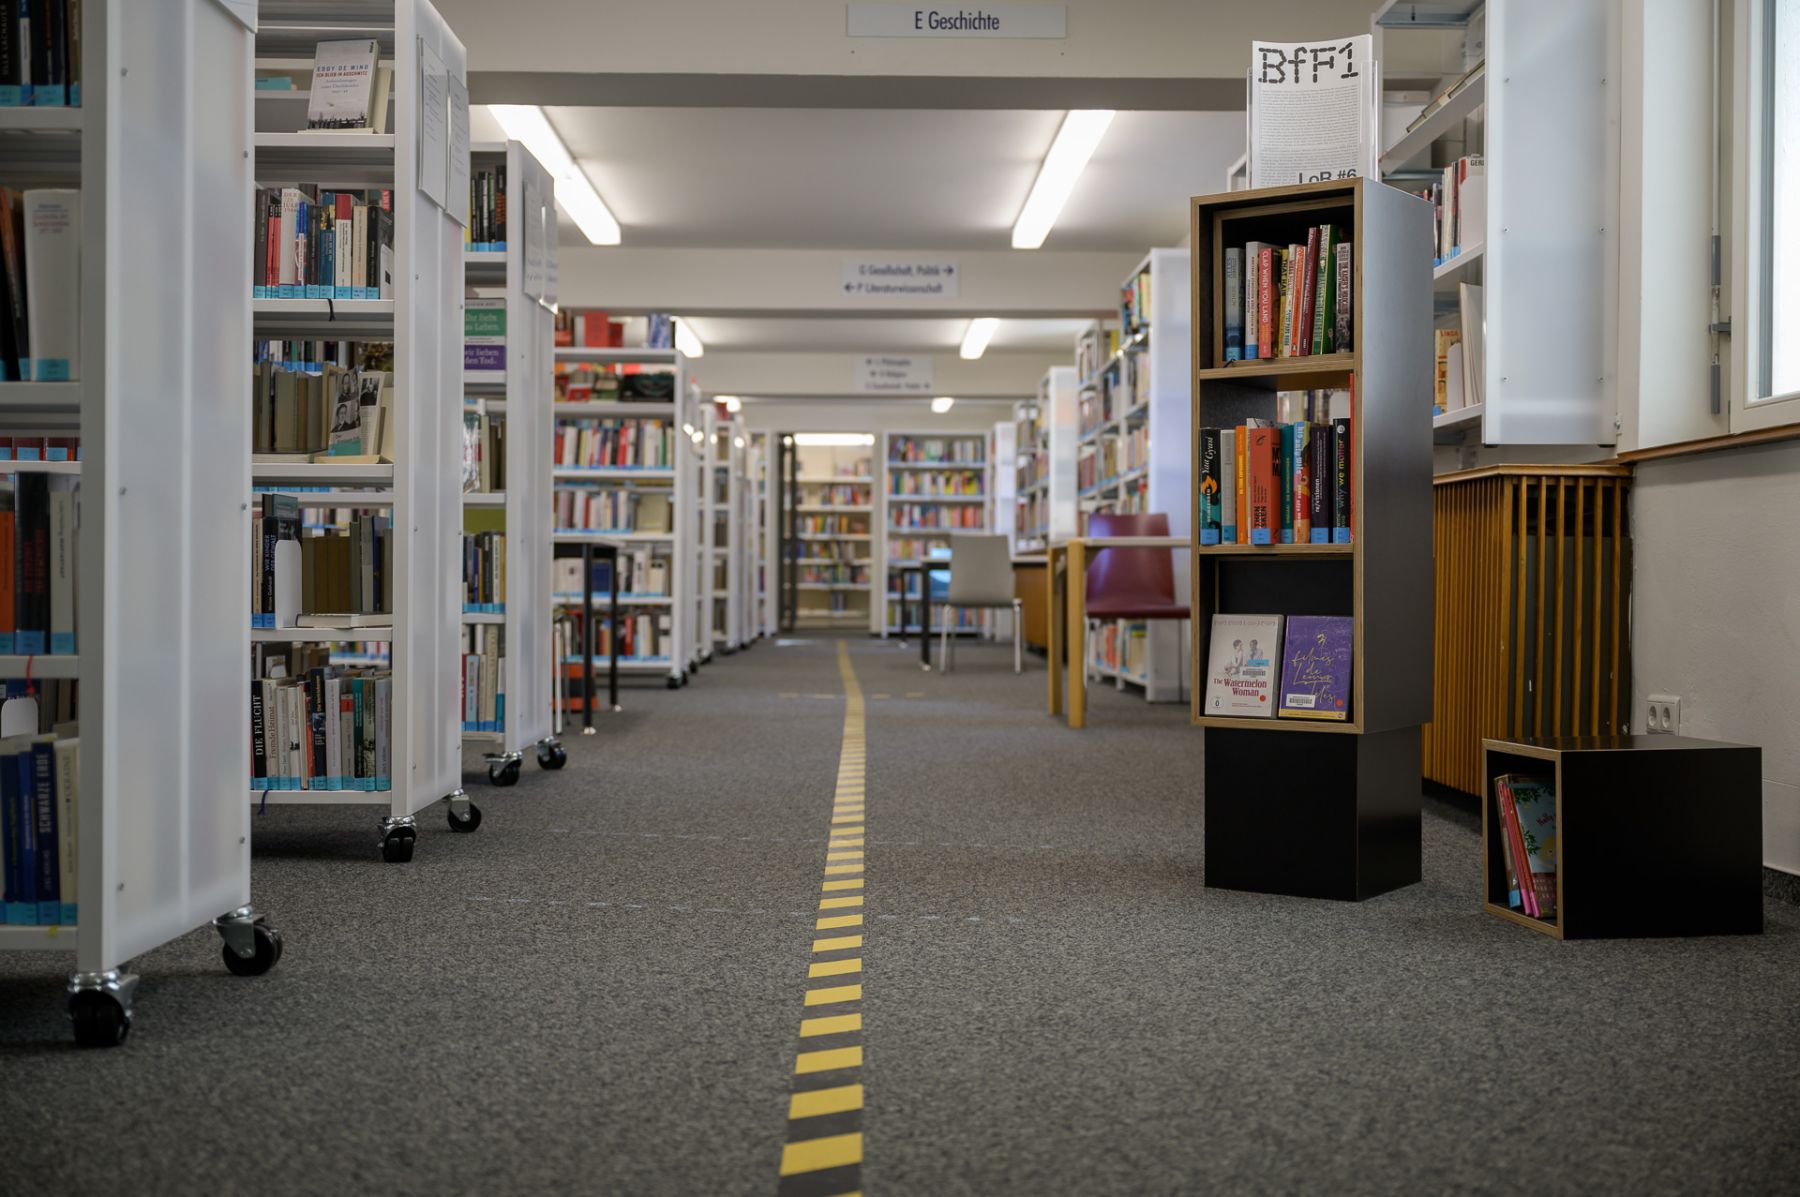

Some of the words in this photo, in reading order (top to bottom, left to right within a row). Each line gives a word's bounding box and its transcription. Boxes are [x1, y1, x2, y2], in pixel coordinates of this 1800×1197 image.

[914, 11, 923, 30] E
[928, 10, 1000, 30] Geschichte
[1337, 168, 1357, 180] #6
[916, 264, 940, 275] Politik
[1205, 437, 1216, 460] Gyasi
[1202, 460, 1210, 474] Yaa
[1339, 472, 1344, 486] we
[1338, 490, 1347, 508] why
[1224, 678, 1267, 688] Watermelon
[1232, 688, 1259, 696] Woman
[253, 695, 263, 734] FLUCHT
[256, 737, 264, 755] DIE
[269, 733, 277, 759] Fremde
[36, 754, 50, 777] ERDE
[37, 782, 52, 833] SCHWARZE
